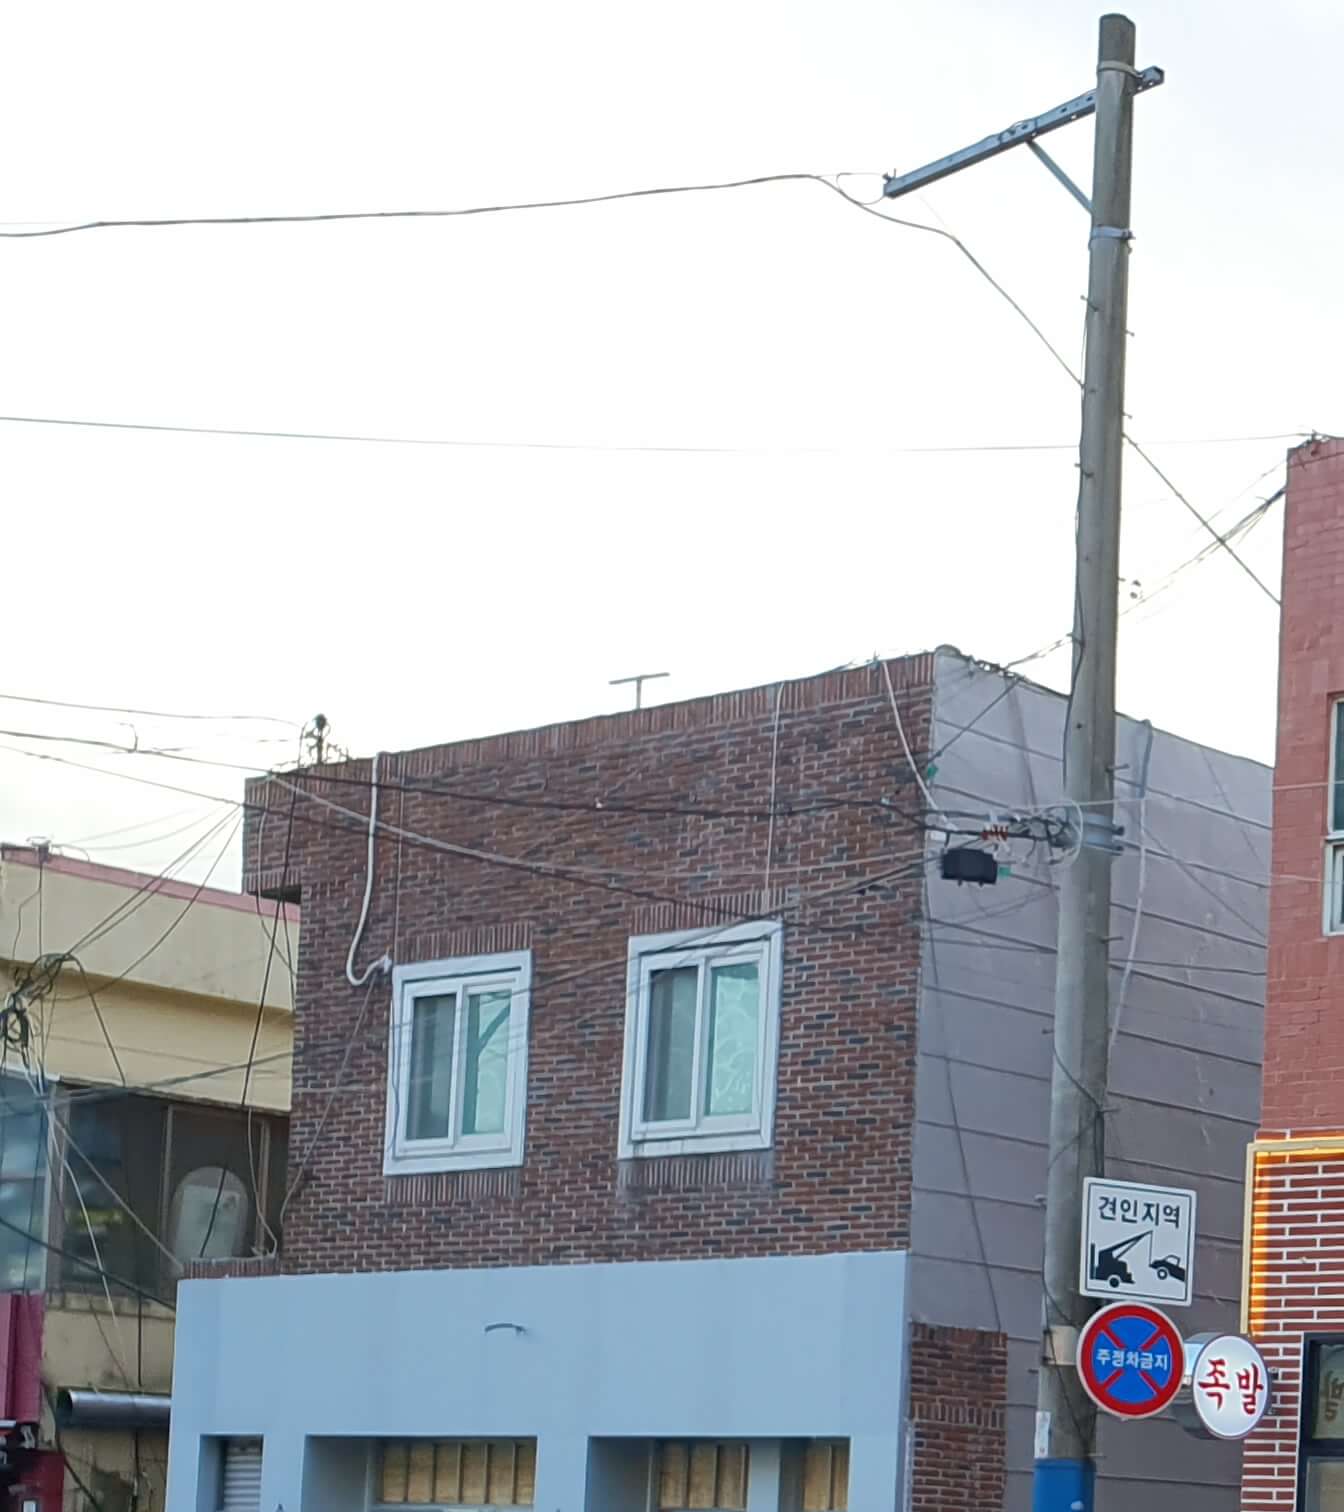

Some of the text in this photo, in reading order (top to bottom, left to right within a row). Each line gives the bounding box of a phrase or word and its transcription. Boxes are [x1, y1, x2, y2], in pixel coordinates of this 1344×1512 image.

[1098, 1196, 1180, 1229] 견인지역
[1096, 1348, 1168, 1371] 주정차금지
[1198, 1357, 1264, 1415] 족발
